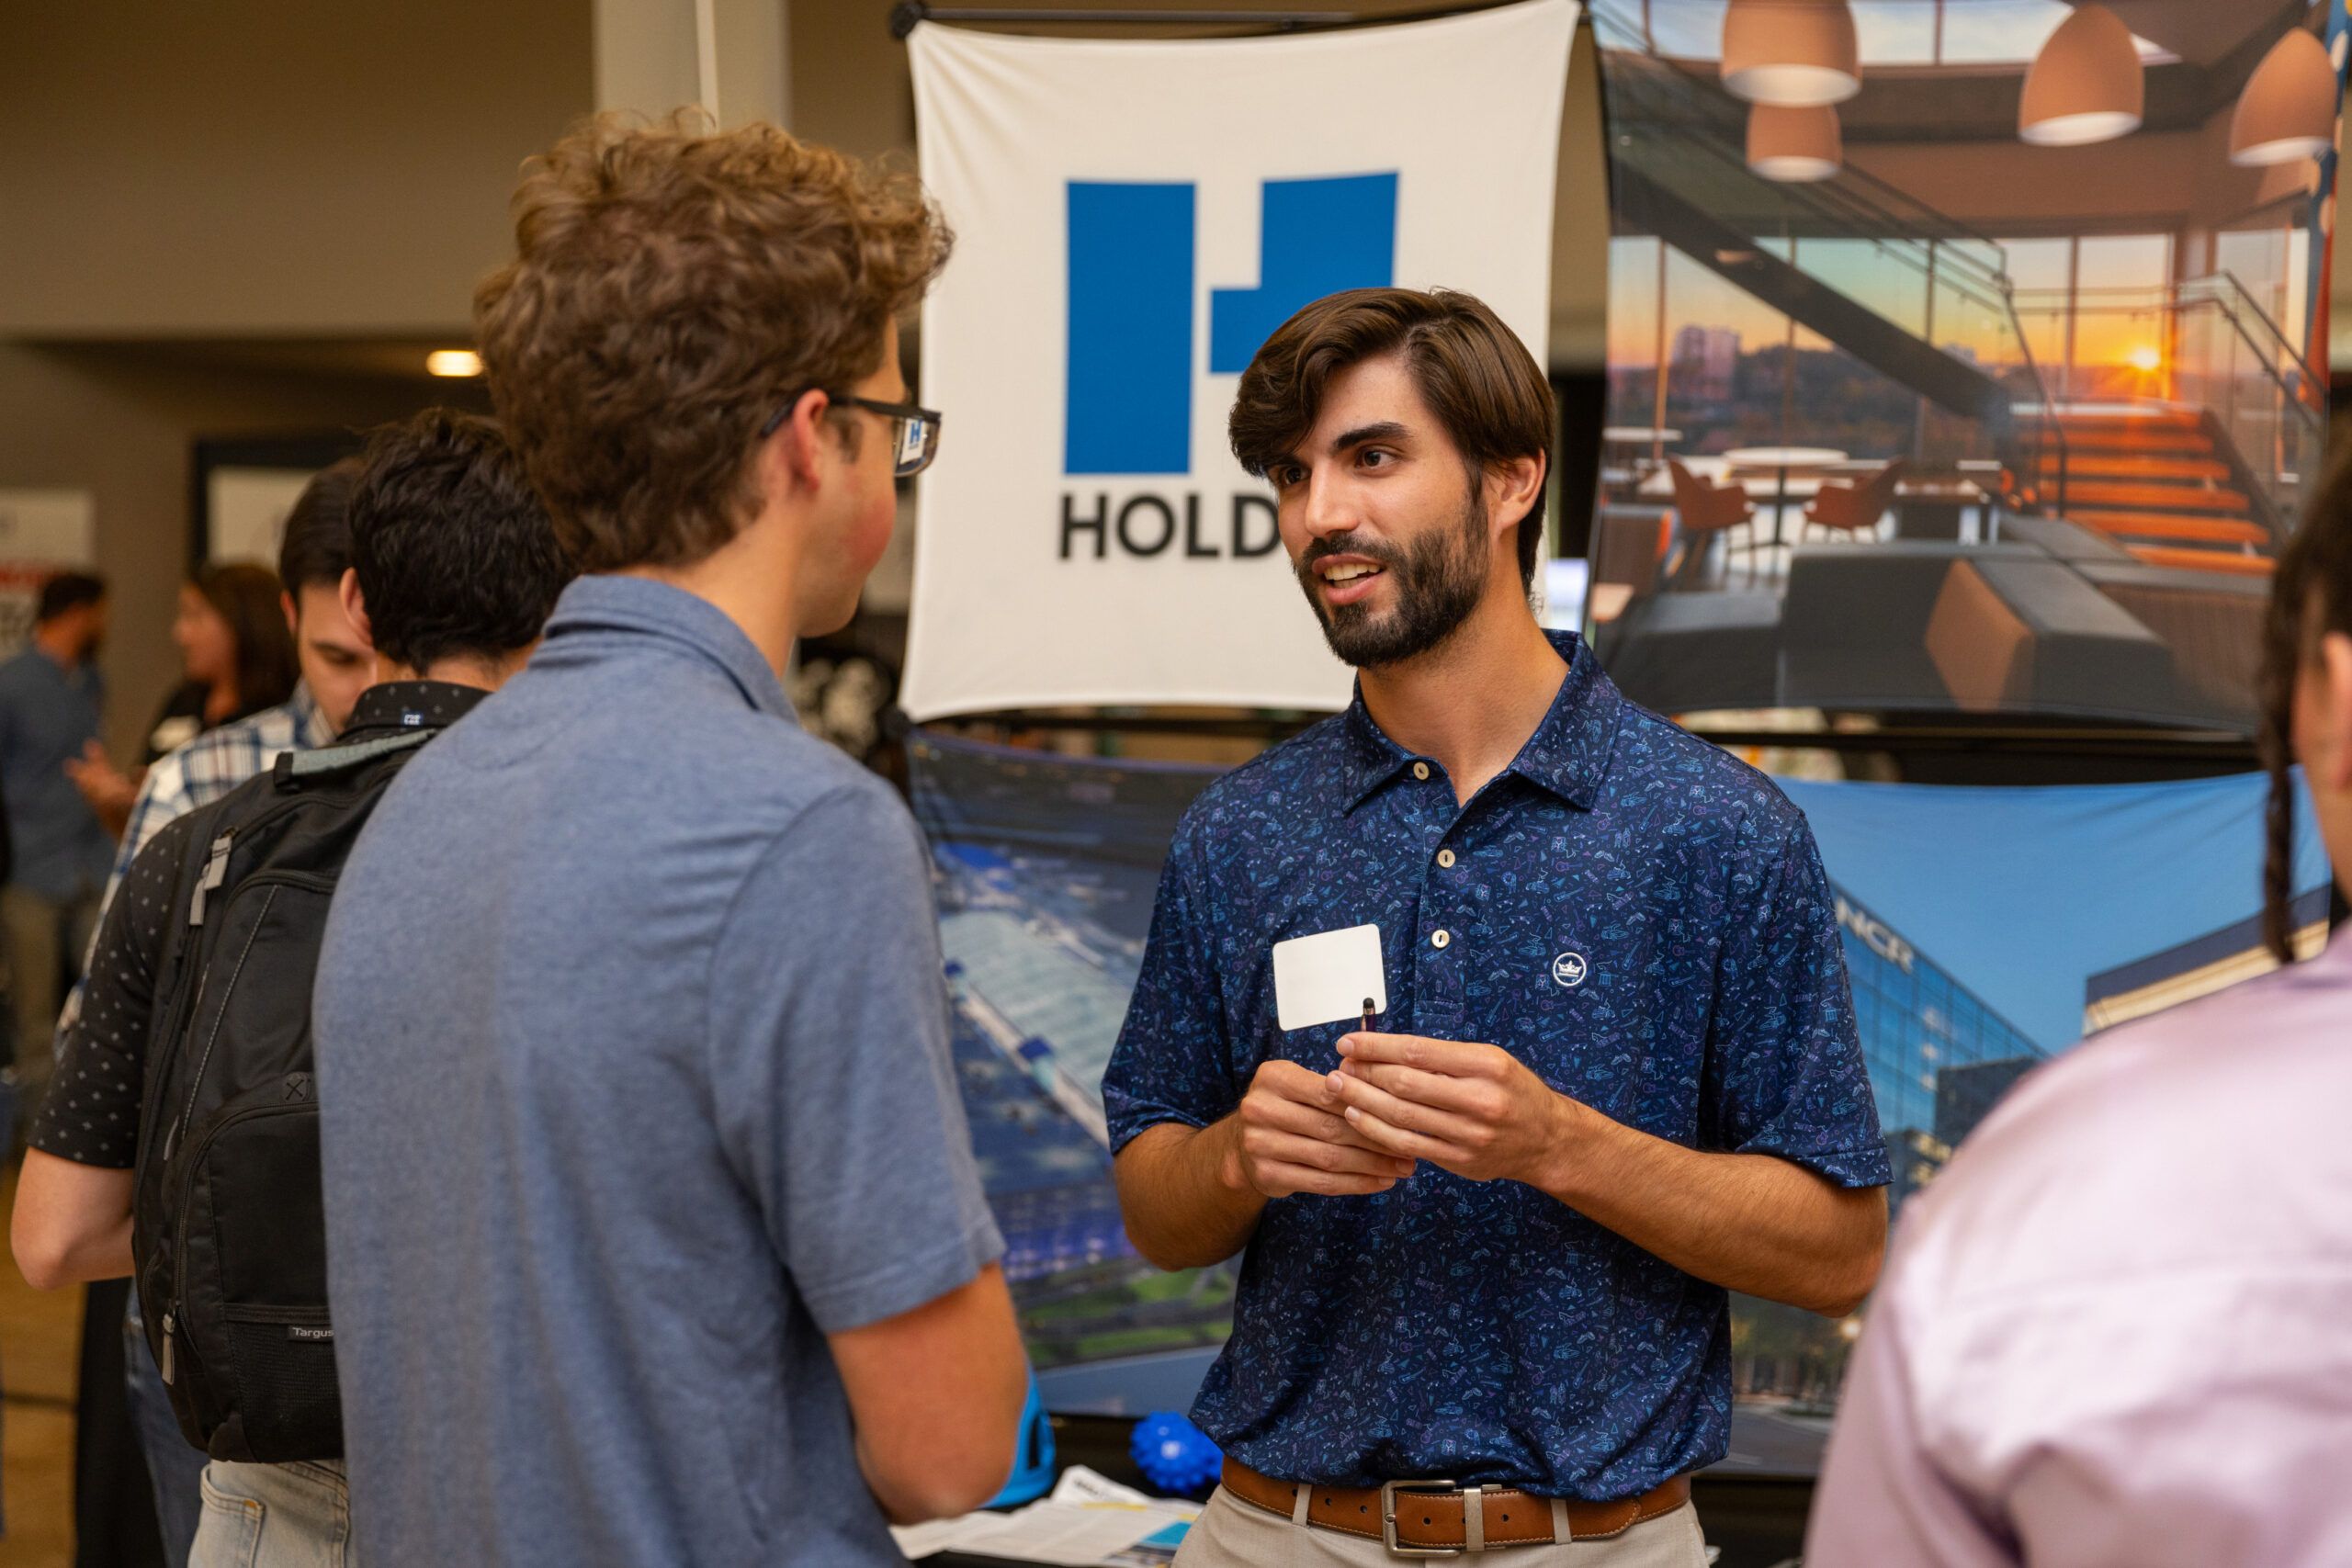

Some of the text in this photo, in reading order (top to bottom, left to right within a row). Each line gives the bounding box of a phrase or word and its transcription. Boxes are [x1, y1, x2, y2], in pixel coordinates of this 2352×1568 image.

[1059, 492, 1283, 560] HOLD
[1835, 897, 1914, 976] NCR
[292, 1326, 334, 1339] Targus
